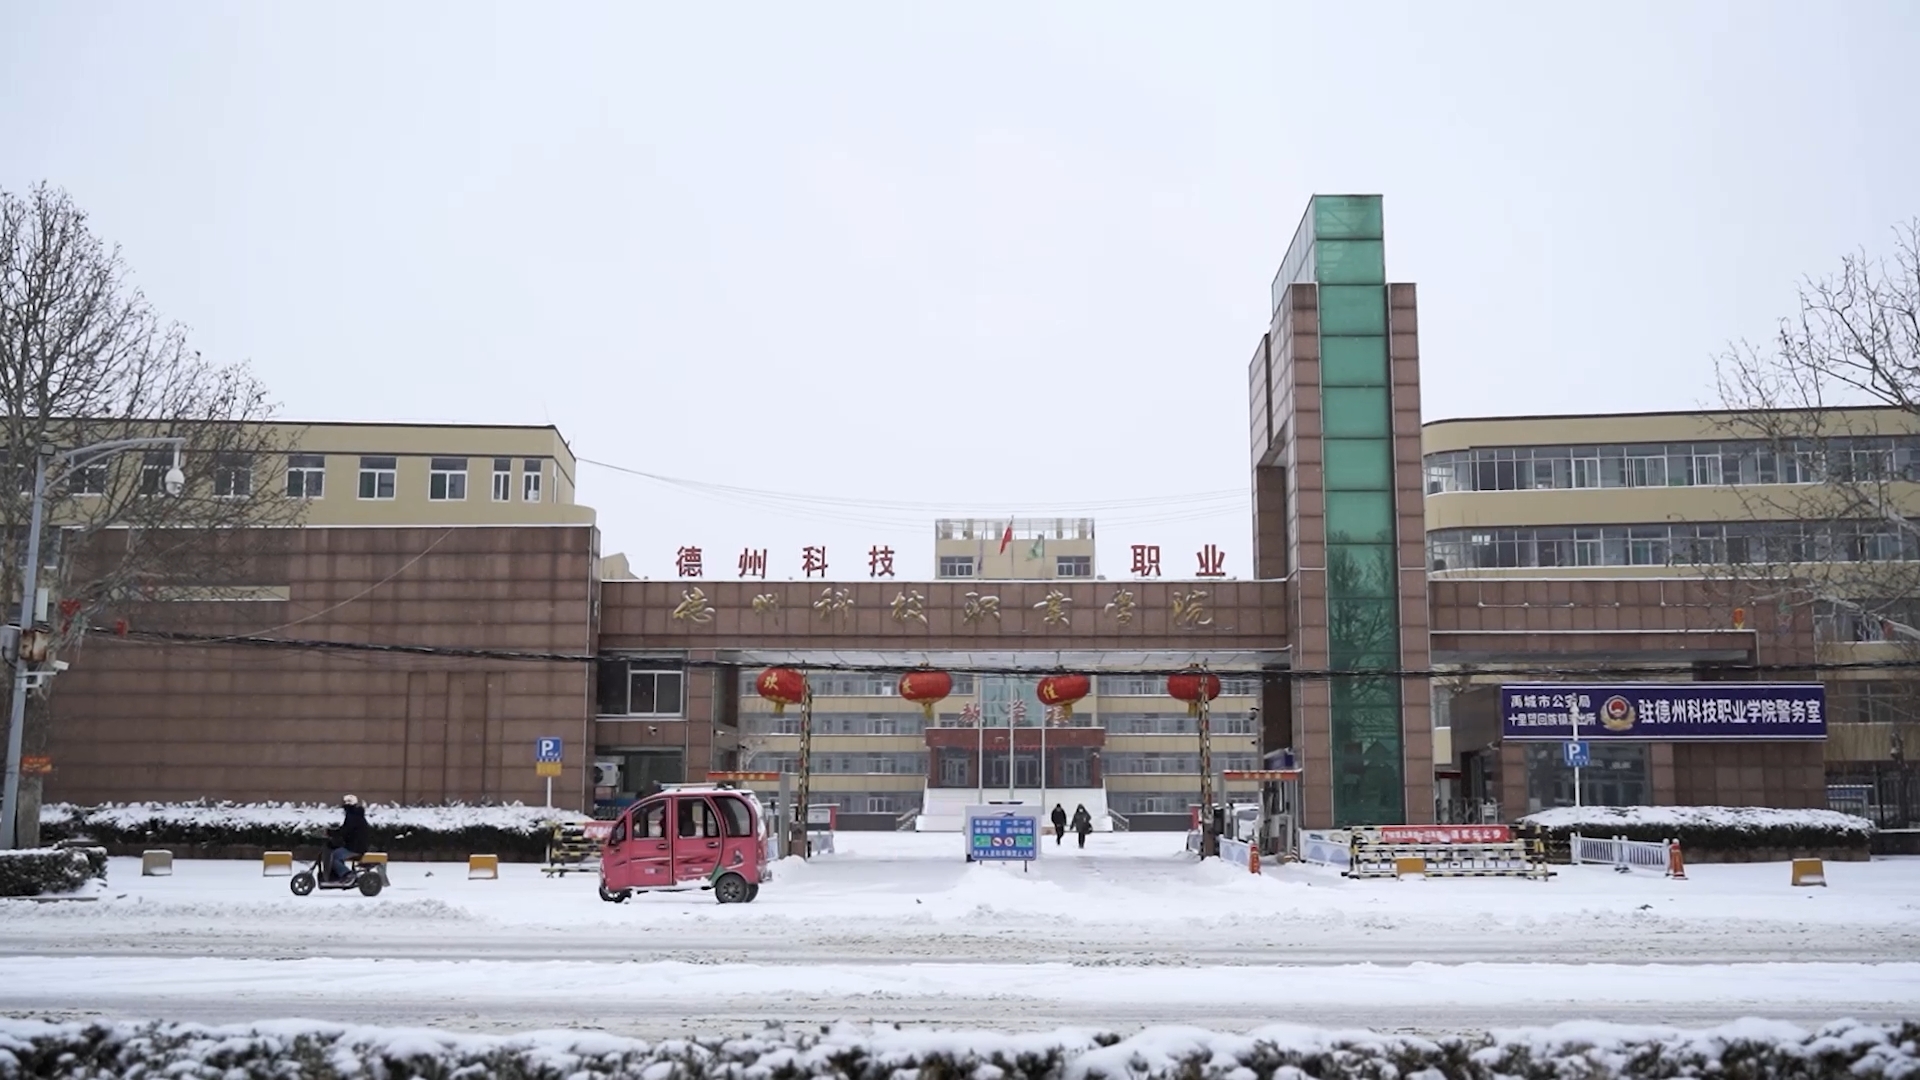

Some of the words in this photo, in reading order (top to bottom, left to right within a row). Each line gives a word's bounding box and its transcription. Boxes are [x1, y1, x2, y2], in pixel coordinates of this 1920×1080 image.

[675, 545, 895, 580] 德州科技
[1130, 544, 1226, 577] 职业
[1638, 698, 1822, 724] 驻德州科技职业学院警务室
[541, 740, 554, 757] P
[1568, 744, 1581, 760] P
